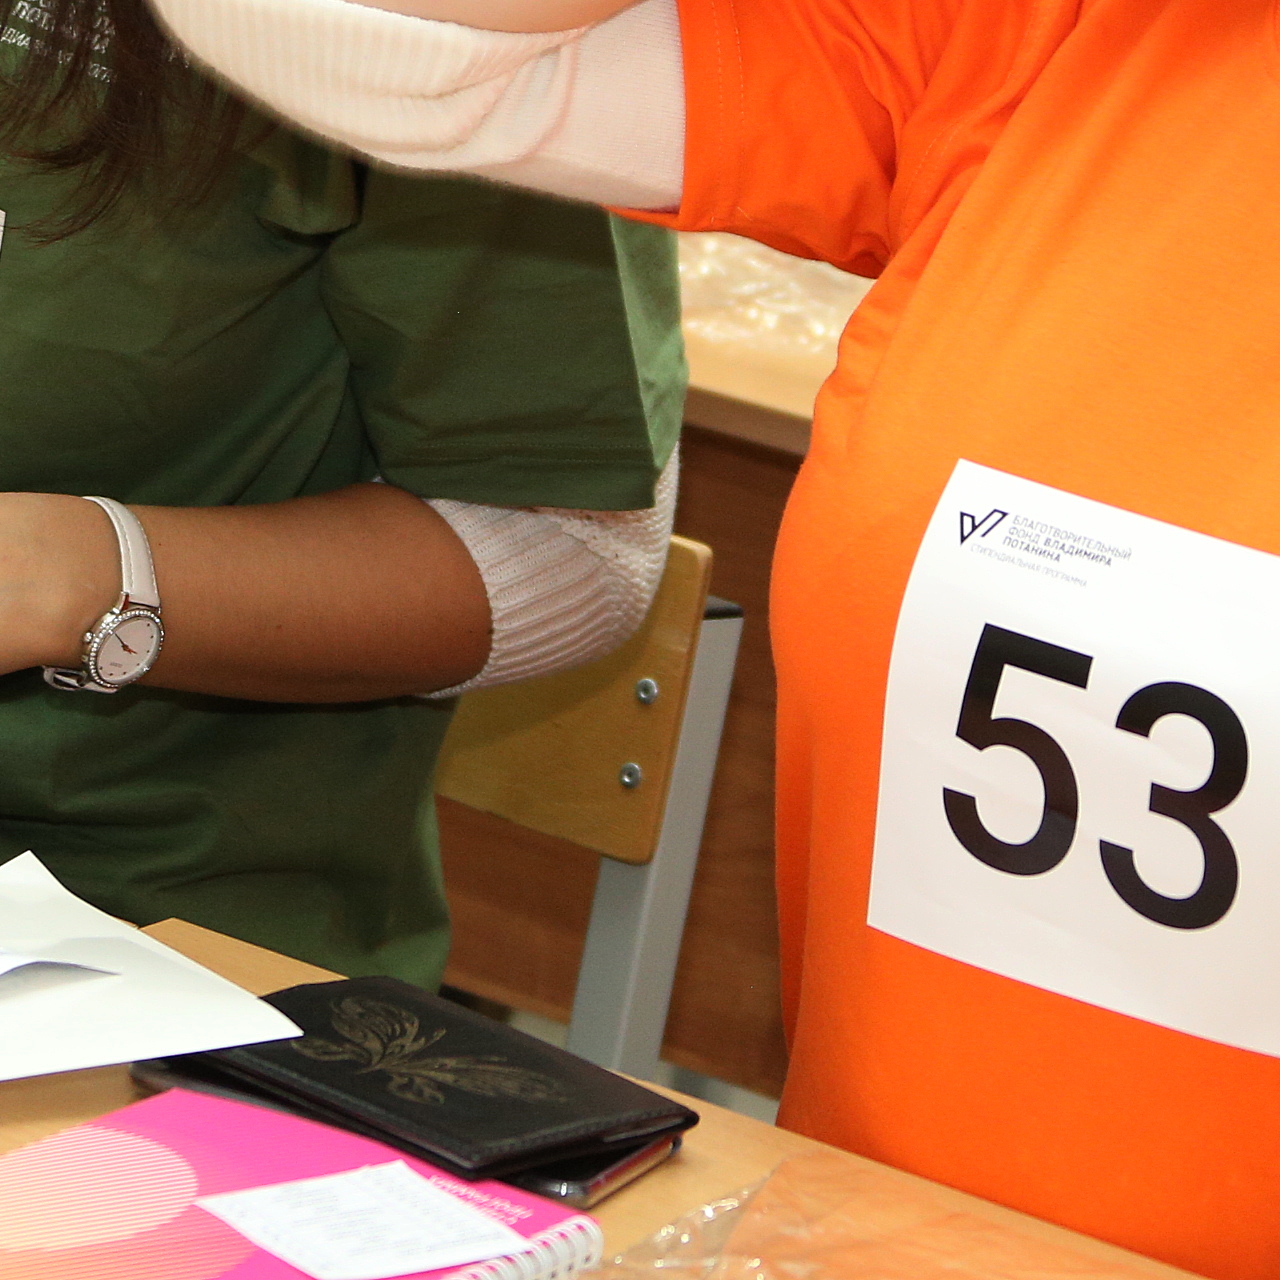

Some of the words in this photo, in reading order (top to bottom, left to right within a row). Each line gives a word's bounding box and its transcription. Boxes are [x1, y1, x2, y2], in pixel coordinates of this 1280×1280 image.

[1002, 536, 1061, 563] ПОТАНИНА
[1008, 526, 1040, 545] ФОНД
[1043, 536, 1112, 567] ВЛАДИМИРА
[1012, 514, 1133, 562] БЛАГОТВОРИТЕЛЬНЫЙ
[942, 622, 1249, 931] 53
